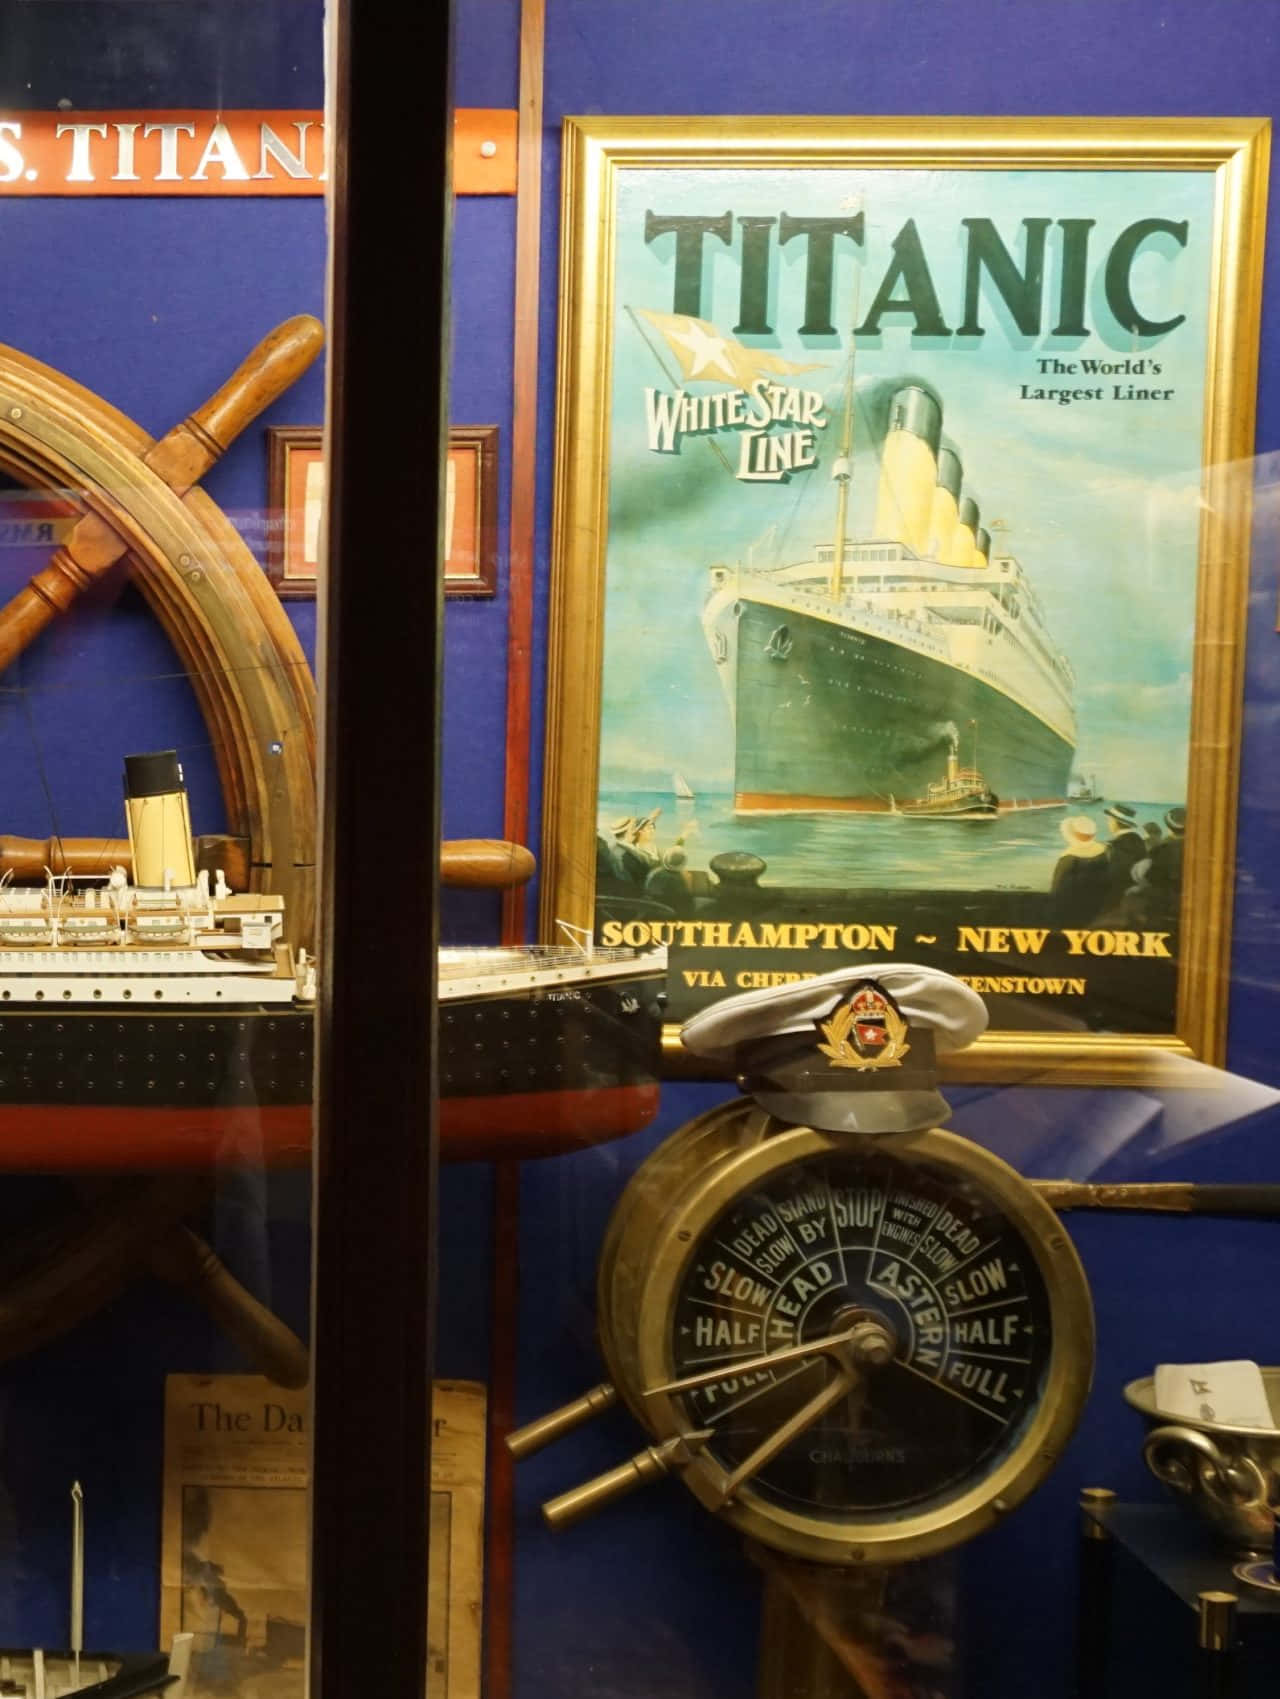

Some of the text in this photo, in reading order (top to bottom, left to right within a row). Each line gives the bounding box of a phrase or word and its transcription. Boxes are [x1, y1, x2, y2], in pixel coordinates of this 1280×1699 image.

[56, 121, 326, 182] TITAN
[645, 211, 1190, 337] TITANIC
[1036, 358, 1162, 375] The World's
[644, 377, 828, 452] WHITE STAR
[1019, 384, 1175, 405] Largest Liner
[735, 428, 818, 482] LINE
[602, 921, 898, 952] SOUTHAMPTON
[957, 926, 1050, 954] NEW
[1063, 929, 1173, 959] YORK
[682, 970, 727, 988] VIA
[834, 1188, 881, 1229] STOP
[732, 1214, 781, 1260] DEAD
[801, 1216, 828, 1245] BY
[881, 1221, 922, 1248] ENGINES
[938, 1210, 981, 1256] DEAD
[756, 1234, 794, 1275] SLOW
[920, 1235, 958, 1274] SLOW
[703, 1260, 772, 1309] SLOW
[944, 1259, 1008, 1307] SLOW
[695, 1316, 761, 1347] HALF
[877, 1260, 946, 1370] ASTERN
[954, 1315, 1019, 1346] HALF
[950, 1363, 1012, 1404] FULL
[189, 1402, 304, 1433] The Da
